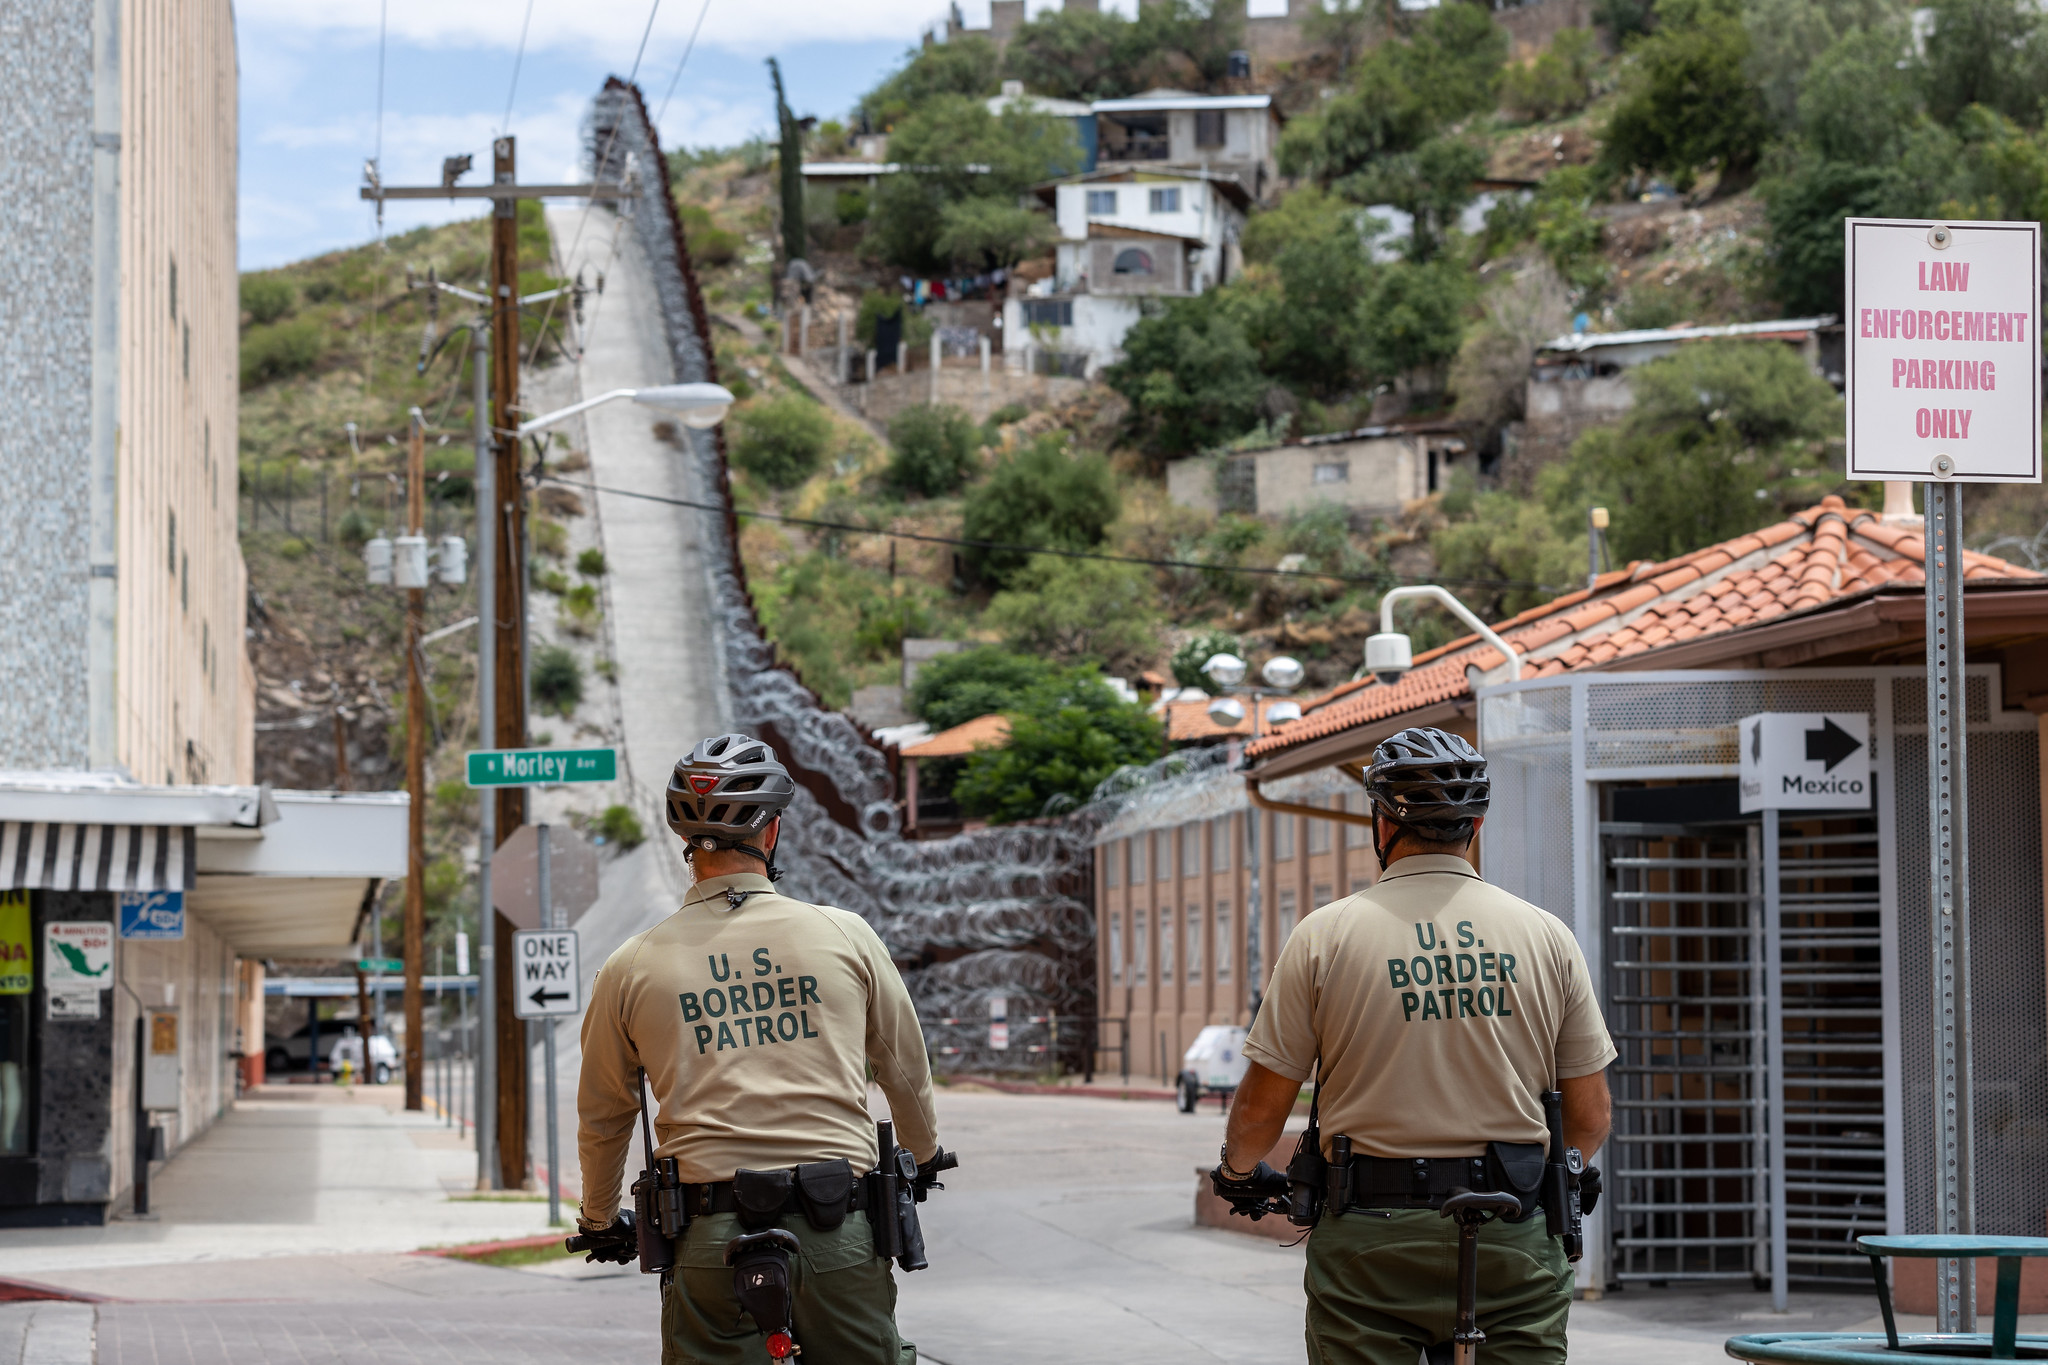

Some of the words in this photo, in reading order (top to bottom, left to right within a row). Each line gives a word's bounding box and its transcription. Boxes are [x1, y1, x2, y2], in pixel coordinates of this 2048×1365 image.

[1918, 261, 1970, 292] LAW
[1861, 308, 2028, 342] ENFORCEMENT
[1892, 358, 1996, 391] PARKING
[1915, 408, 1973, 439] ONLY
[502, 753, 568, 782] Morley
[1782, 774, 1864, 795] Mexico
[523, 937, 570, 958] ONE
[524, 961, 570, 980] WAY
[1387, 952, 1518, 989] BORDER
[678, 975, 823, 1023] BORDER
[1401, 986, 1513, 1022] PATROL
[694, 1010, 819, 1055] PATROL
